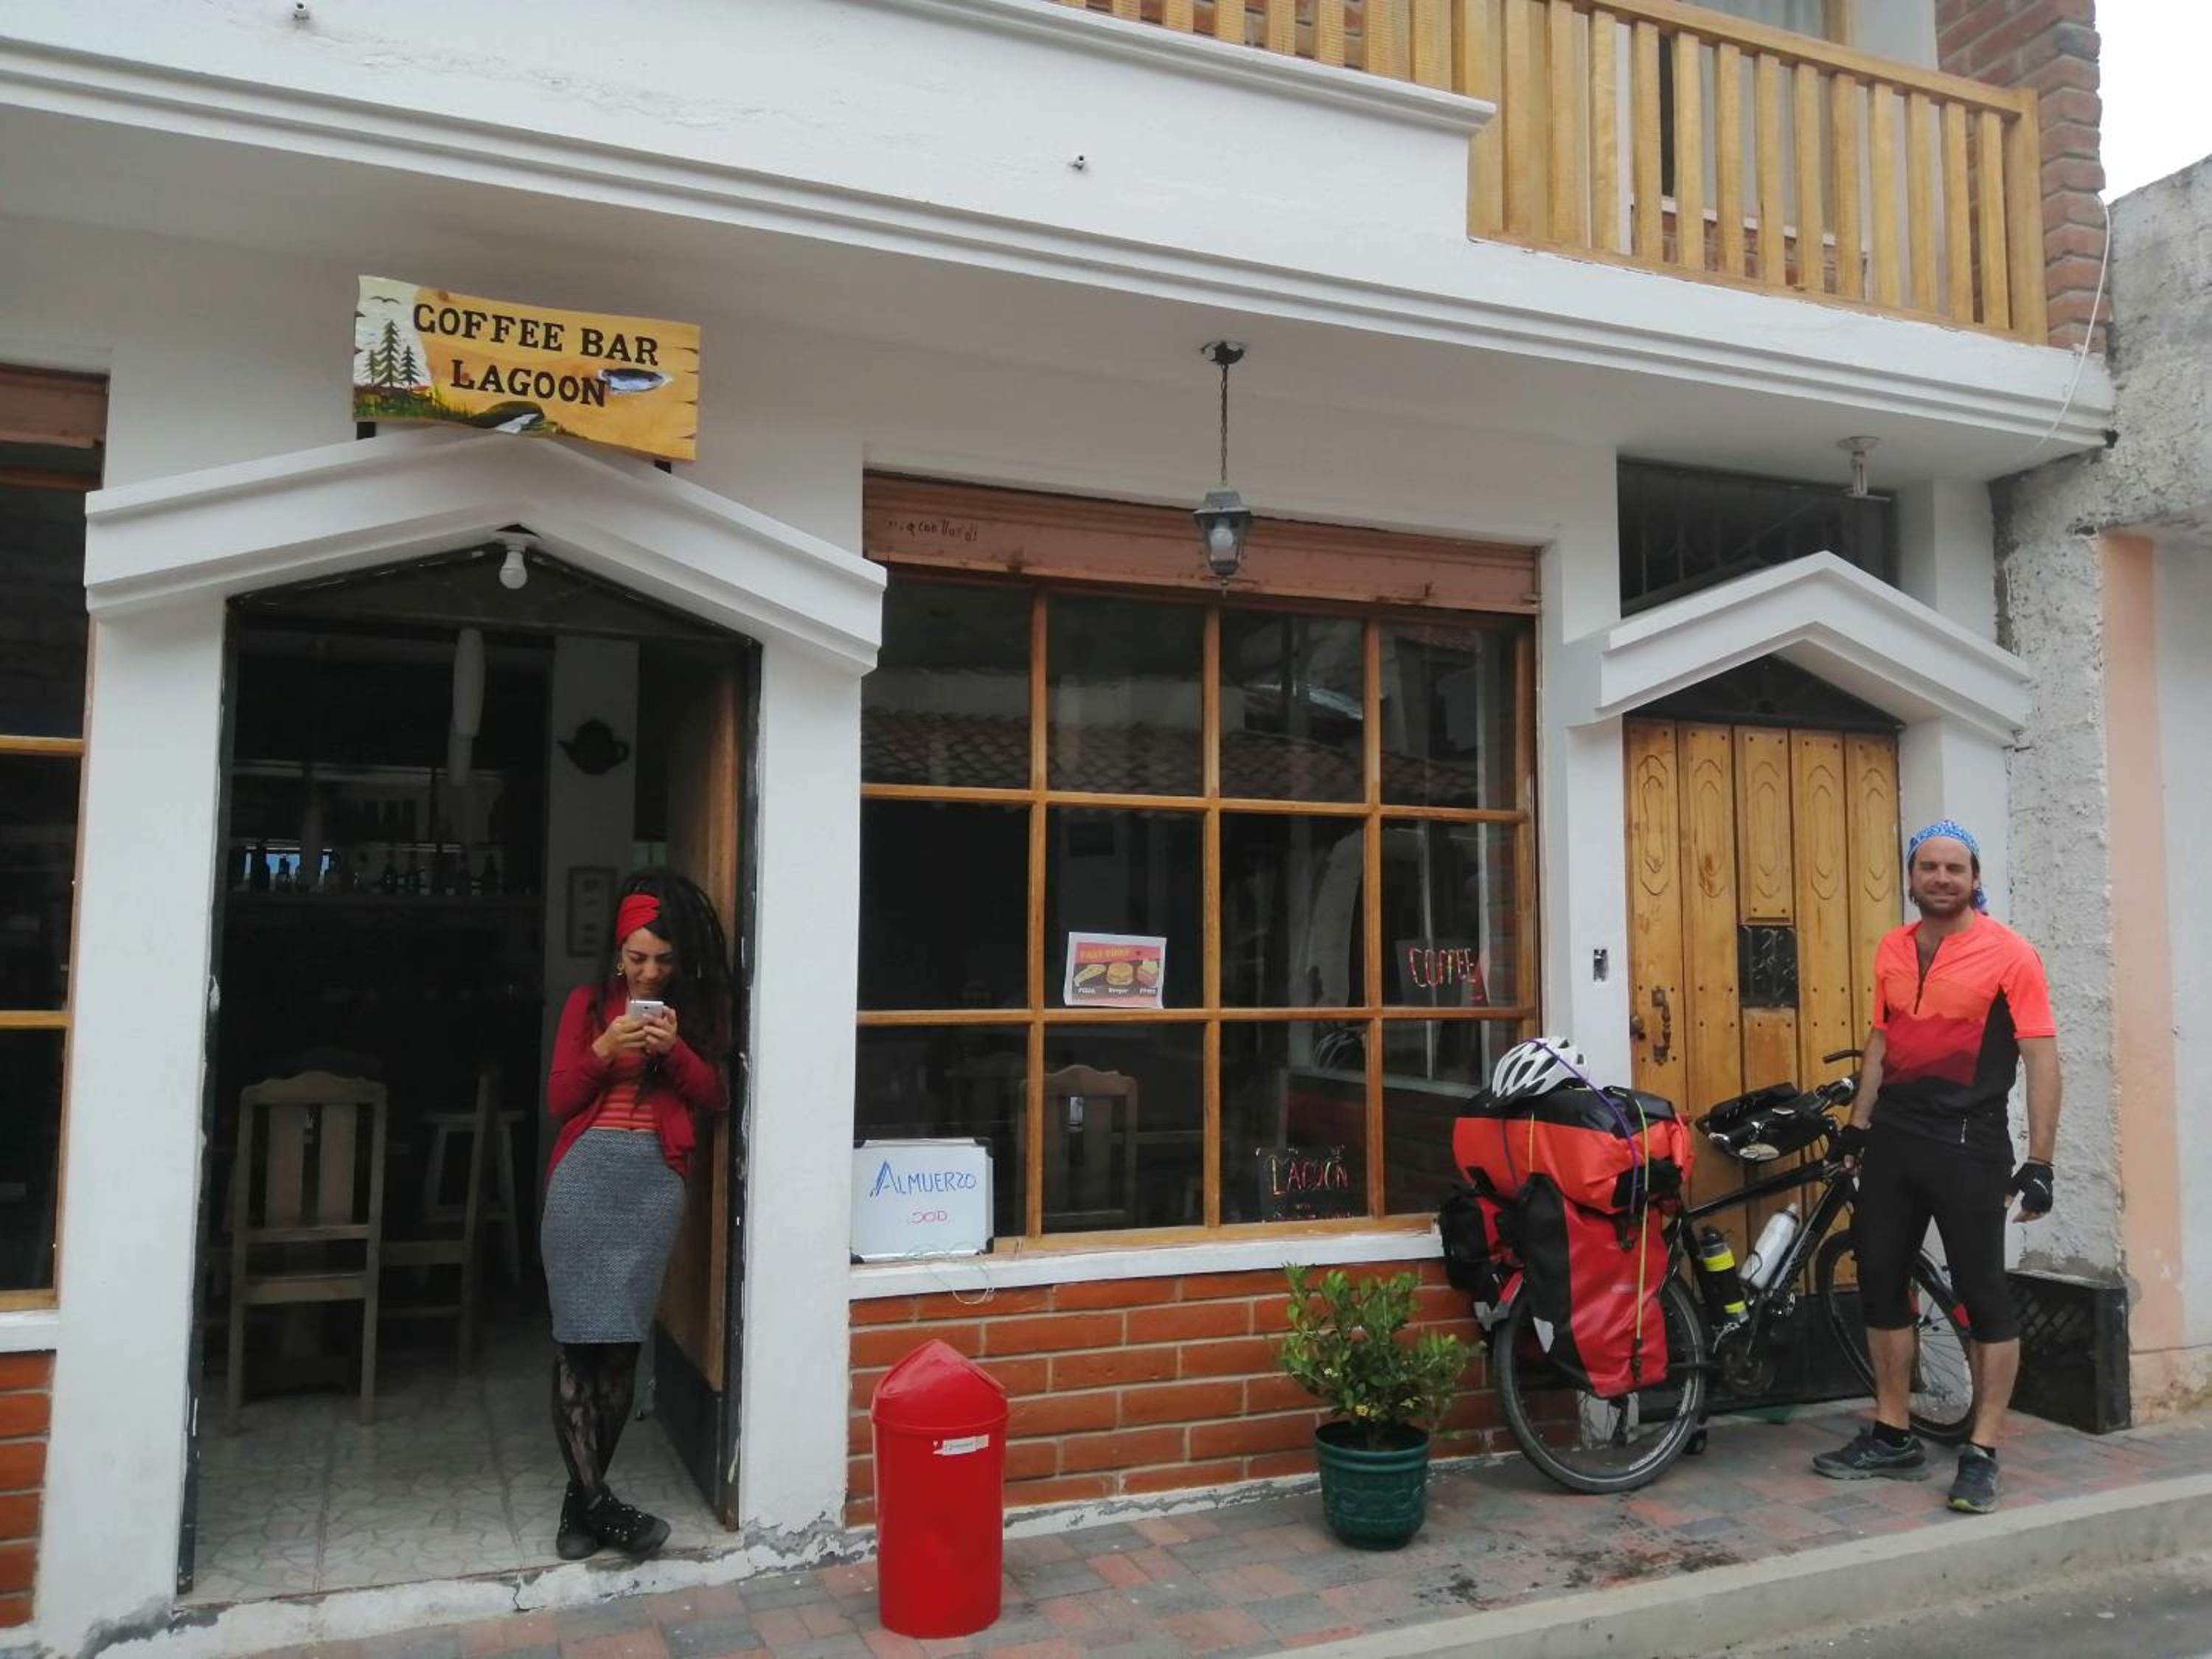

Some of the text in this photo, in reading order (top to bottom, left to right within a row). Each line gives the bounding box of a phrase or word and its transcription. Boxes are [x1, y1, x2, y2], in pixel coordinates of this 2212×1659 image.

[413, 303, 658, 366] COFFEE BAR
[451, 358, 606, 407] LAGOON
[869, 1161, 977, 1197] ALMUERZO
